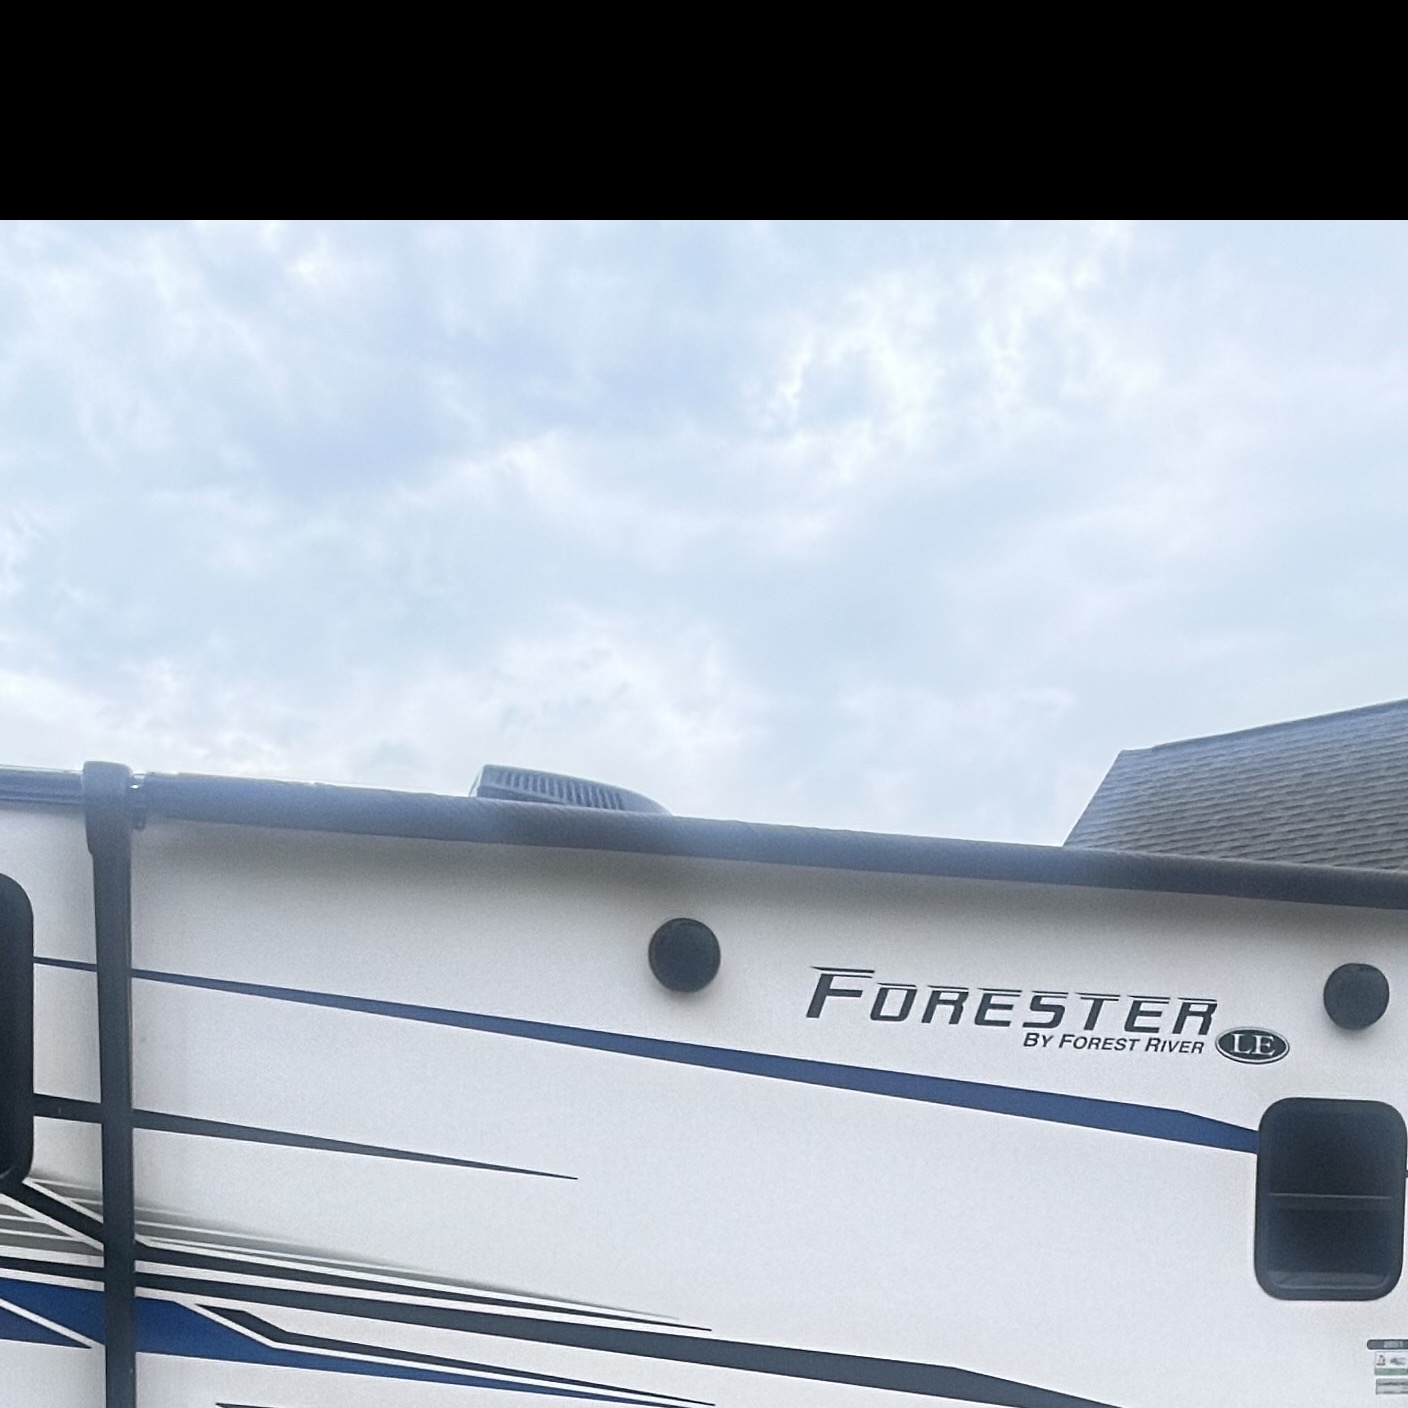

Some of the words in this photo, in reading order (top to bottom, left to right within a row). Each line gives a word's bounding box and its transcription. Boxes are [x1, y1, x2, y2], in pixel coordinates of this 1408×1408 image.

[805, 965, 1218, 1036] FORESTER
[1022, 1032, 1058, 1048] BY
[1058, 1033, 1140, 1052] FOREST
[1144, 1036, 1205, 1055] RIVER
[1229, 1032, 1277, 1057] LE
